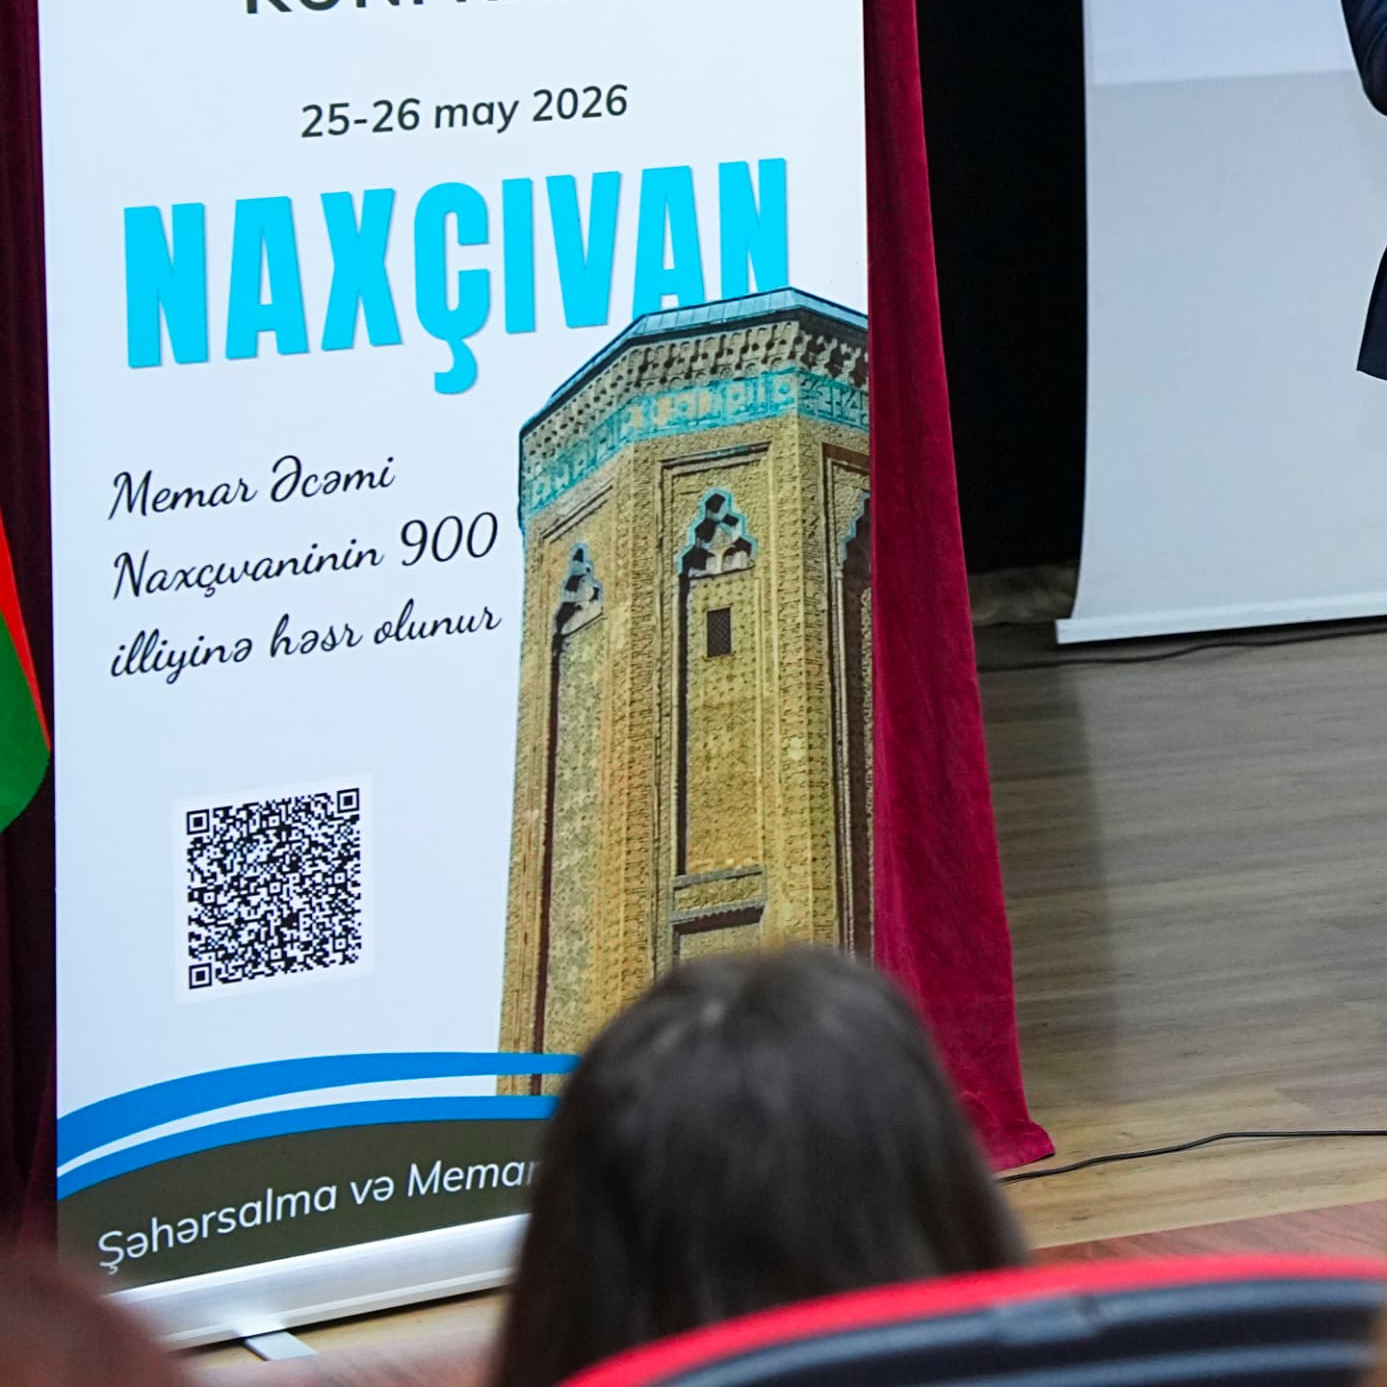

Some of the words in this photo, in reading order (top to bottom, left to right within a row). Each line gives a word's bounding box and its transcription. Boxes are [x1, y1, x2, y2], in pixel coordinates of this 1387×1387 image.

[300, 97, 422, 139] 25-26
[433, 94, 520, 133] may
[531, 83, 629, 124] 2026
[123, 157, 791, 396] NAXÇIVAN
[107, 469, 258, 521] Memar
[269, 454, 397, 503] Əcəmi
[400, 511, 500, 567] 900
[109, 628, 254, 685] illiyinə
[269, 613, 363, 659] həsr
[373, 597, 503, 646] olunur
[97, 1182, 338, 1275] Şəhərsalma
[350, 1174, 395, 1207] və
